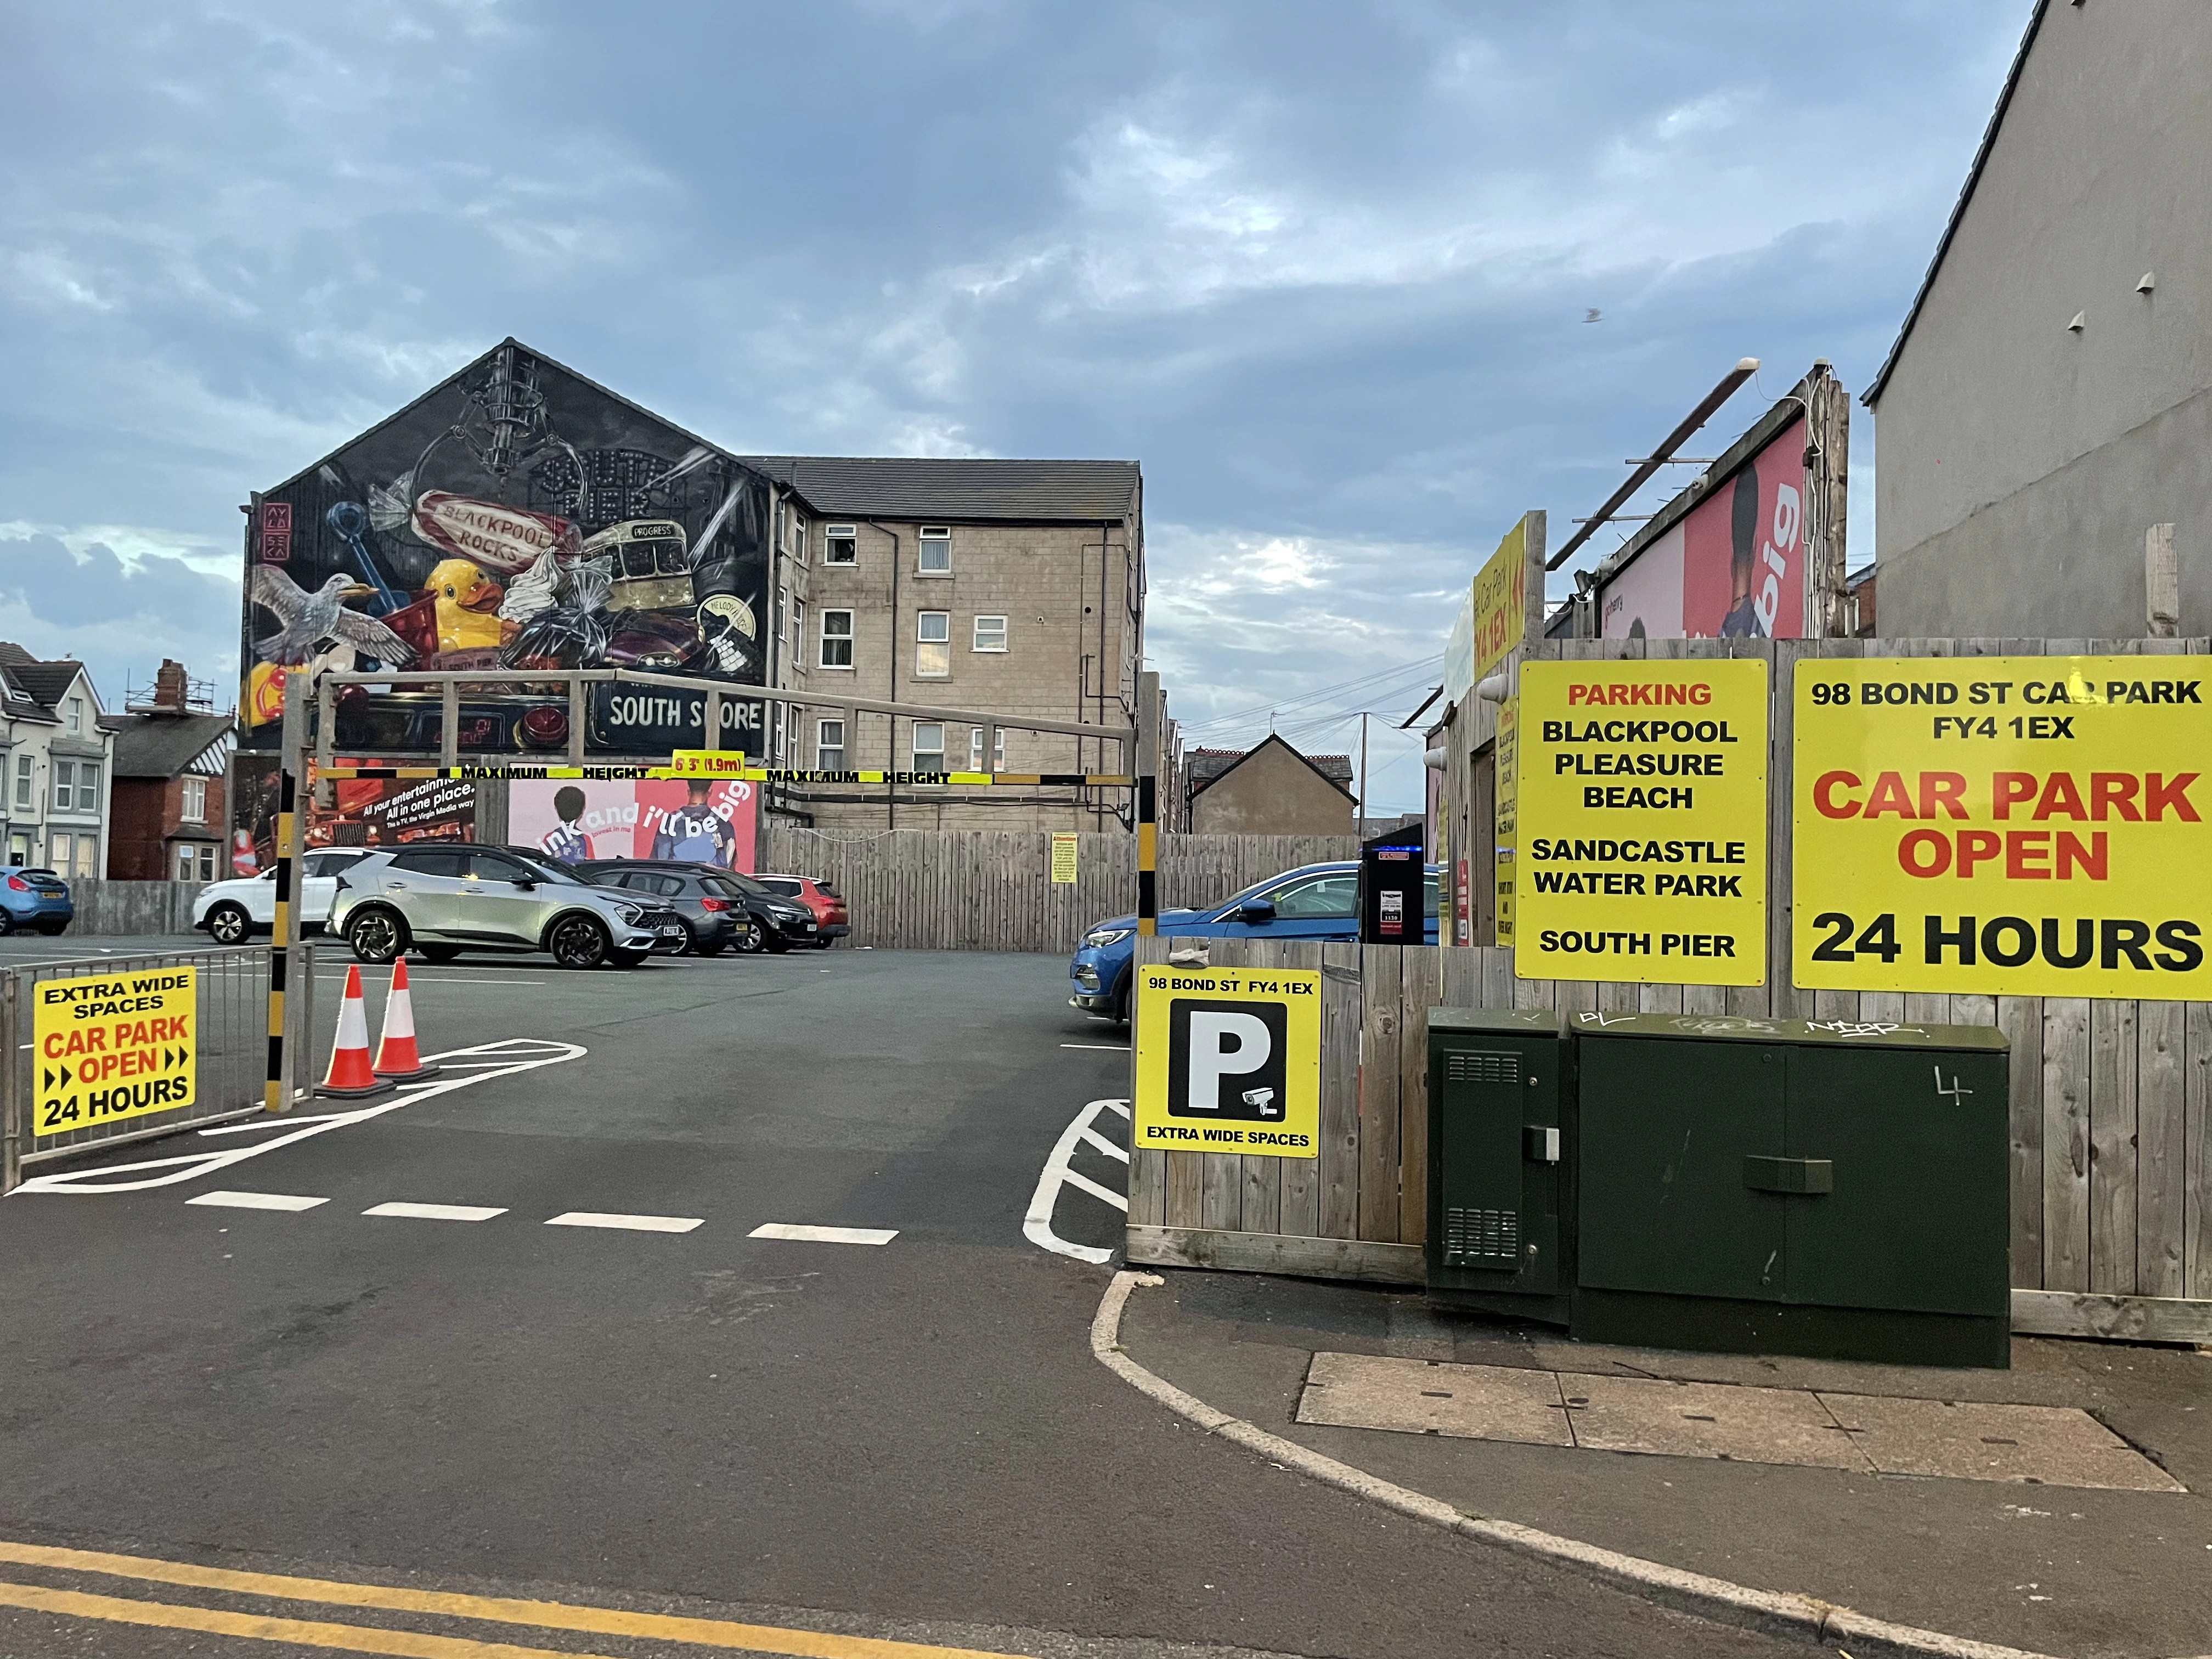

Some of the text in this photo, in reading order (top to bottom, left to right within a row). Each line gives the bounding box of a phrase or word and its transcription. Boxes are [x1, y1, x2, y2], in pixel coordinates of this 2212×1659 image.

[444, 506, 549, 549] BLACKPOOL
[635, 526, 671, 537] PROGRESS
[1754, 483, 1800, 638] big
[1481, 582, 1492, 614] Car
[1493, 557, 1507, 602] Park
[732, 609, 747, 629] HUSE
[1475, 601, 1506, 668] Y4 1EX
[1568, 684, 1712, 706] PARKING
[1812, 683, 1850, 706] 98
[1861, 682, 1959, 706] BOND
[1969, 681, 2013, 704] ST
[2107, 681, 2202, 704] PARK
[611, 696, 762, 730] SOUTH SORE
[1543, 721, 1738, 743] BLACKPOOL
[1933, 716, 2075, 740] FY4 1EX
[461, 768, 951, 783] MAXIMUM HEIGHT MAXIMUM HEIGHT
[704, 758, 741, 771] (1.9m)
[1555, 753, 1723, 776] PLEASURE
[364, 778, 460, 817] All your entertainm
[386, 783, 475, 821] All in one place.
[419, 810, 435, 820] Virgin
[436, 804, 457, 815] Media
[458, 799, 475, 811] way
[1584, 787, 1693, 809] BEACH
[1813, 770, 2203, 823] CAR PARK
[535, 781, 751, 855] ink and i'll be big
[1532, 839, 1746, 864] SANDCASTLE
[1898, 828, 2108, 881] OPEN
[1533, 872, 1646, 895] WATER
[1655, 874, 1742, 898] PARK
[1539, 930, 1736, 958] SOUTH PIER
[1812, 912, 2204, 972] 24 HOURS
[45, 975, 189, 1005] EXTRA WIDE
[1149, 978, 1313, 995] 98 BOND ST FY4 1EX
[74, 996, 163, 1019] SPACES
[44, 1014, 188, 1059] CAR PARK
[78, 1048, 156, 1083] OPEN
[1189, 1011, 1271, 1109] P
[44, 1076, 188, 1127] 24 HOURS
[1147, 1126, 1310, 1147] EXTRA WIDE SPACES
